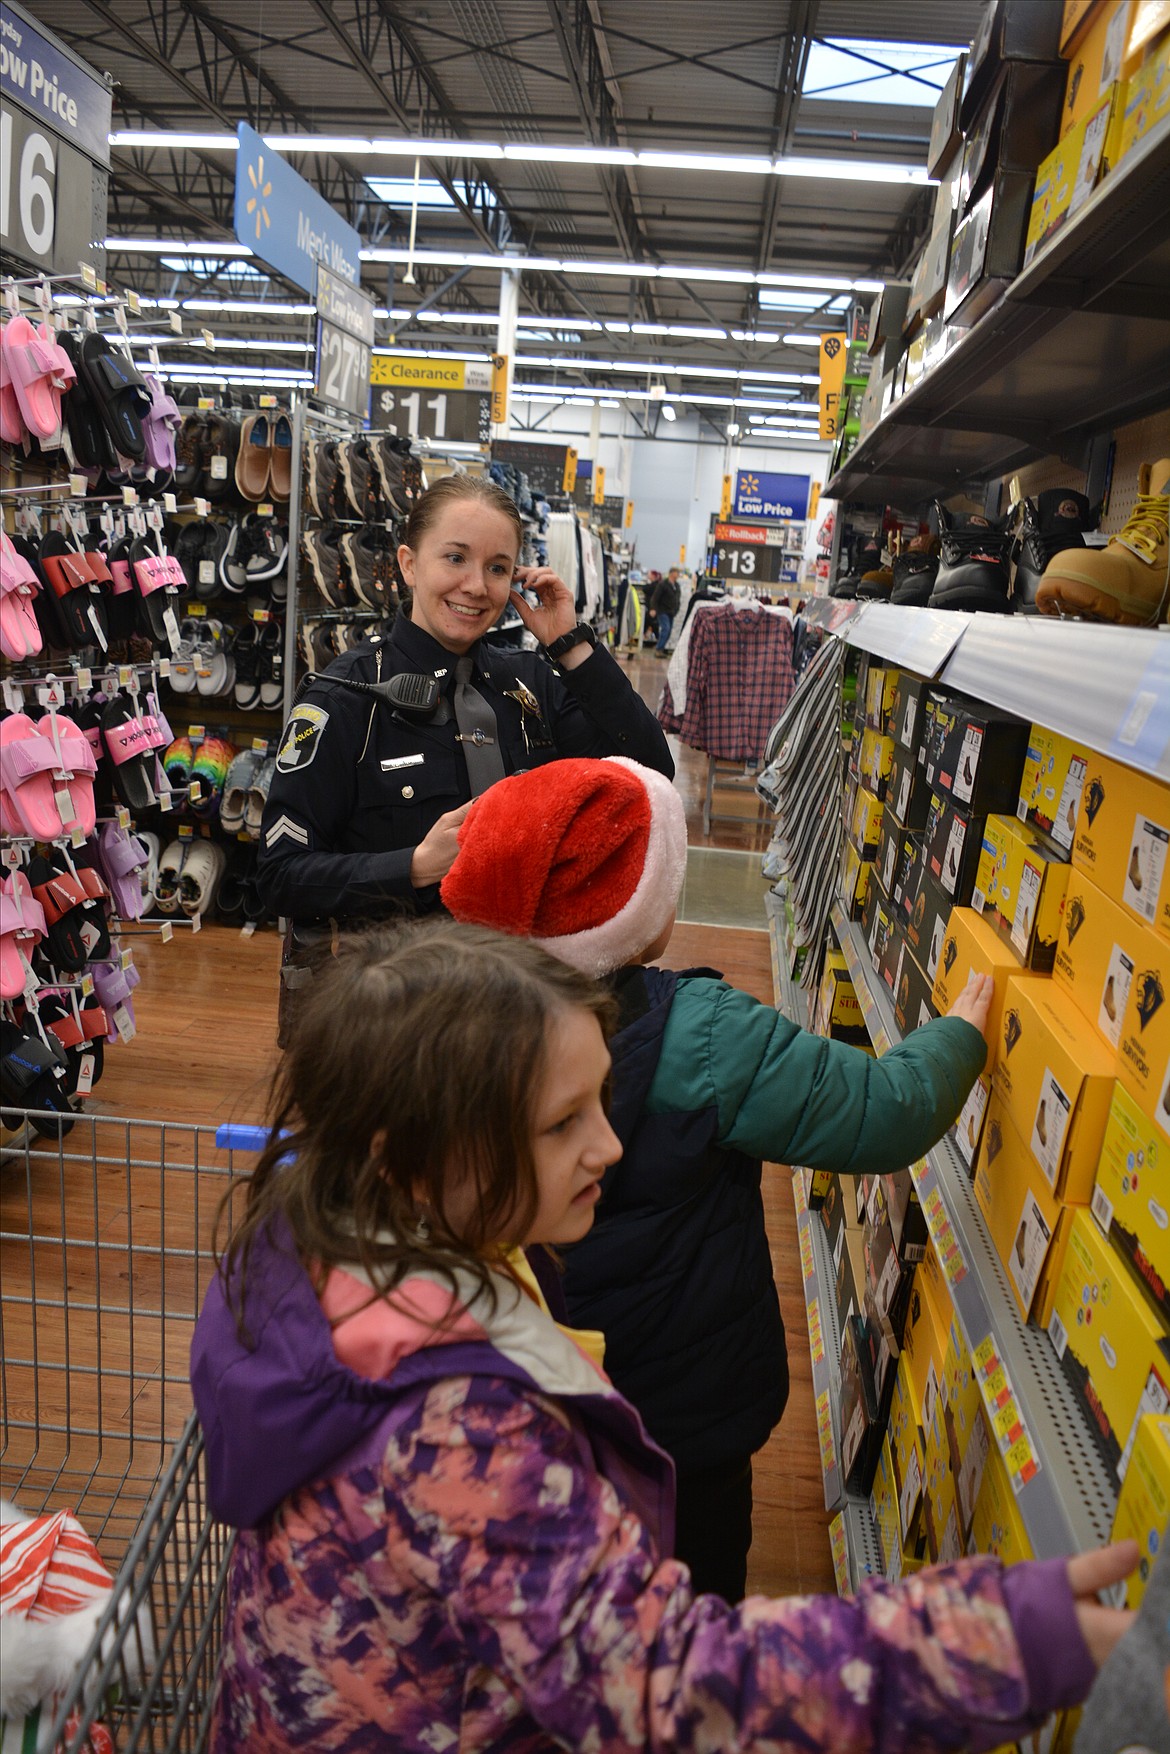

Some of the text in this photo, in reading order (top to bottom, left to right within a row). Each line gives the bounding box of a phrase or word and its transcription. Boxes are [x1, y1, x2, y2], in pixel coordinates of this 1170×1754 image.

[0, 18, 22, 48] yday
[31, 59, 78, 128] Price
[297, 209, 330, 265] Men's
[391, 364, 459, 382] Clearance
[738, 502, 762, 513] Low
[763, 503, 794, 517] Price
[729, 529, 765, 541] Rollback
[294, 727, 315, 744] POLICE
